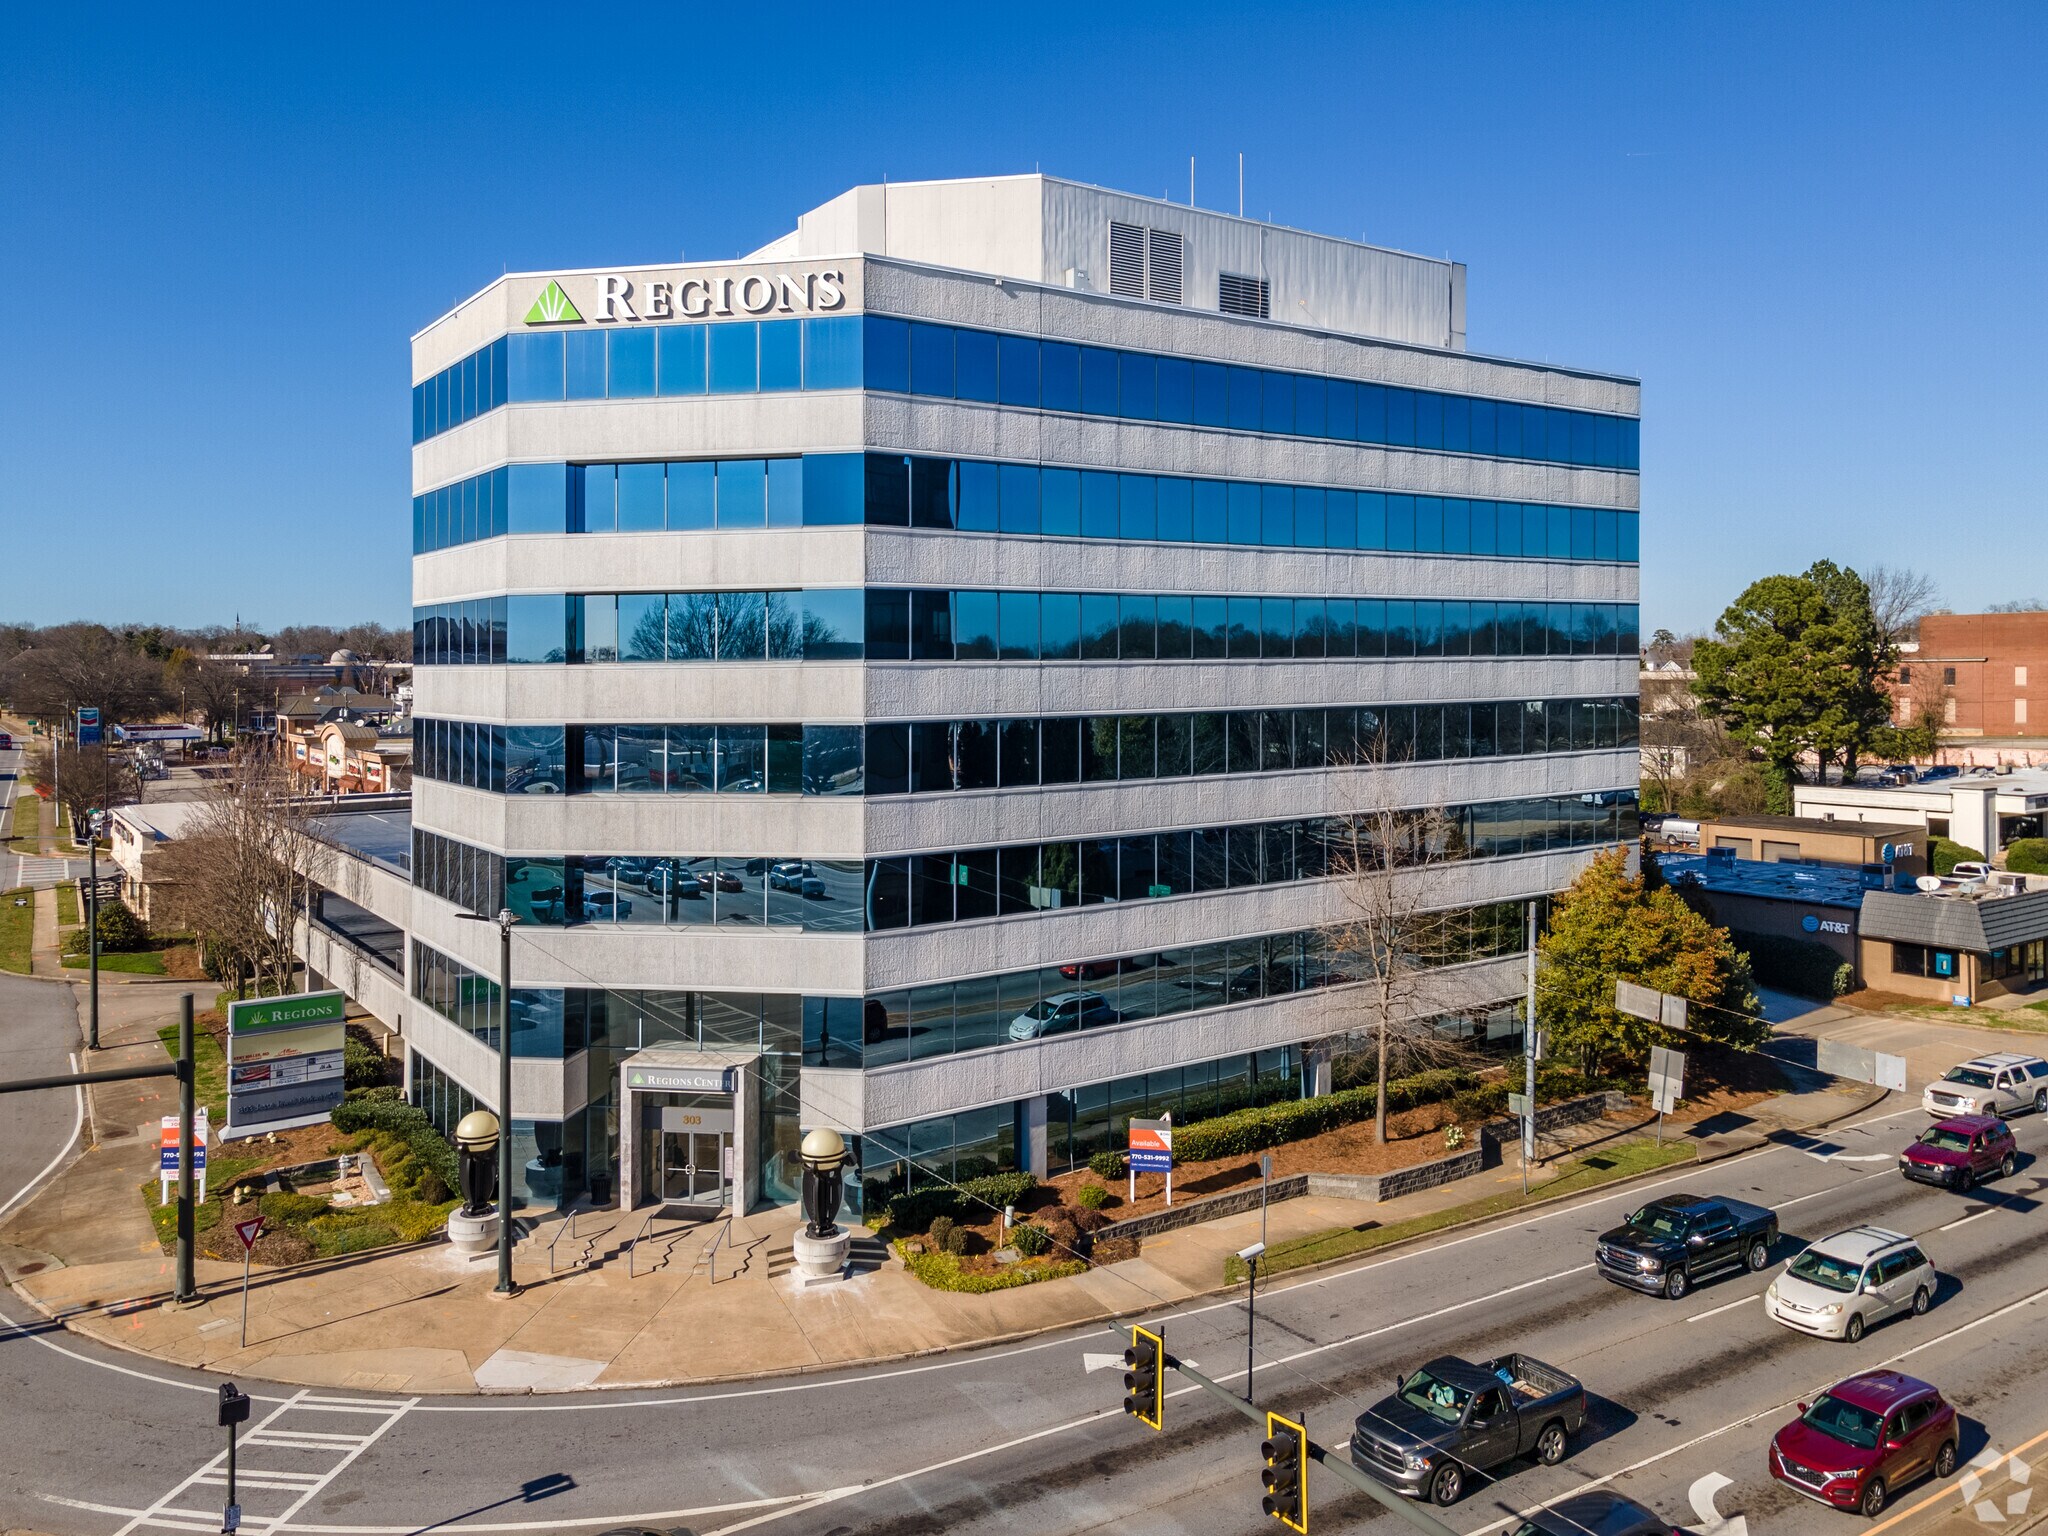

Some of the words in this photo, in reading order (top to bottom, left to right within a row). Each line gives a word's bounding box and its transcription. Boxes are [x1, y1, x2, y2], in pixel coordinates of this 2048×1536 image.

[593, 270, 844, 321] REGIONS
[1895, 842, 1914, 858] AT&T
[1820, 920, 1850, 934] AT&T
[272, 1005, 333, 1022] REGIONS
[648, 1075, 692, 1086] REGIONS
[693, 1076, 731, 1088] CENTER
[682, 1115, 702, 1125] 303
[1132, 1140, 1160, 1148] Available
